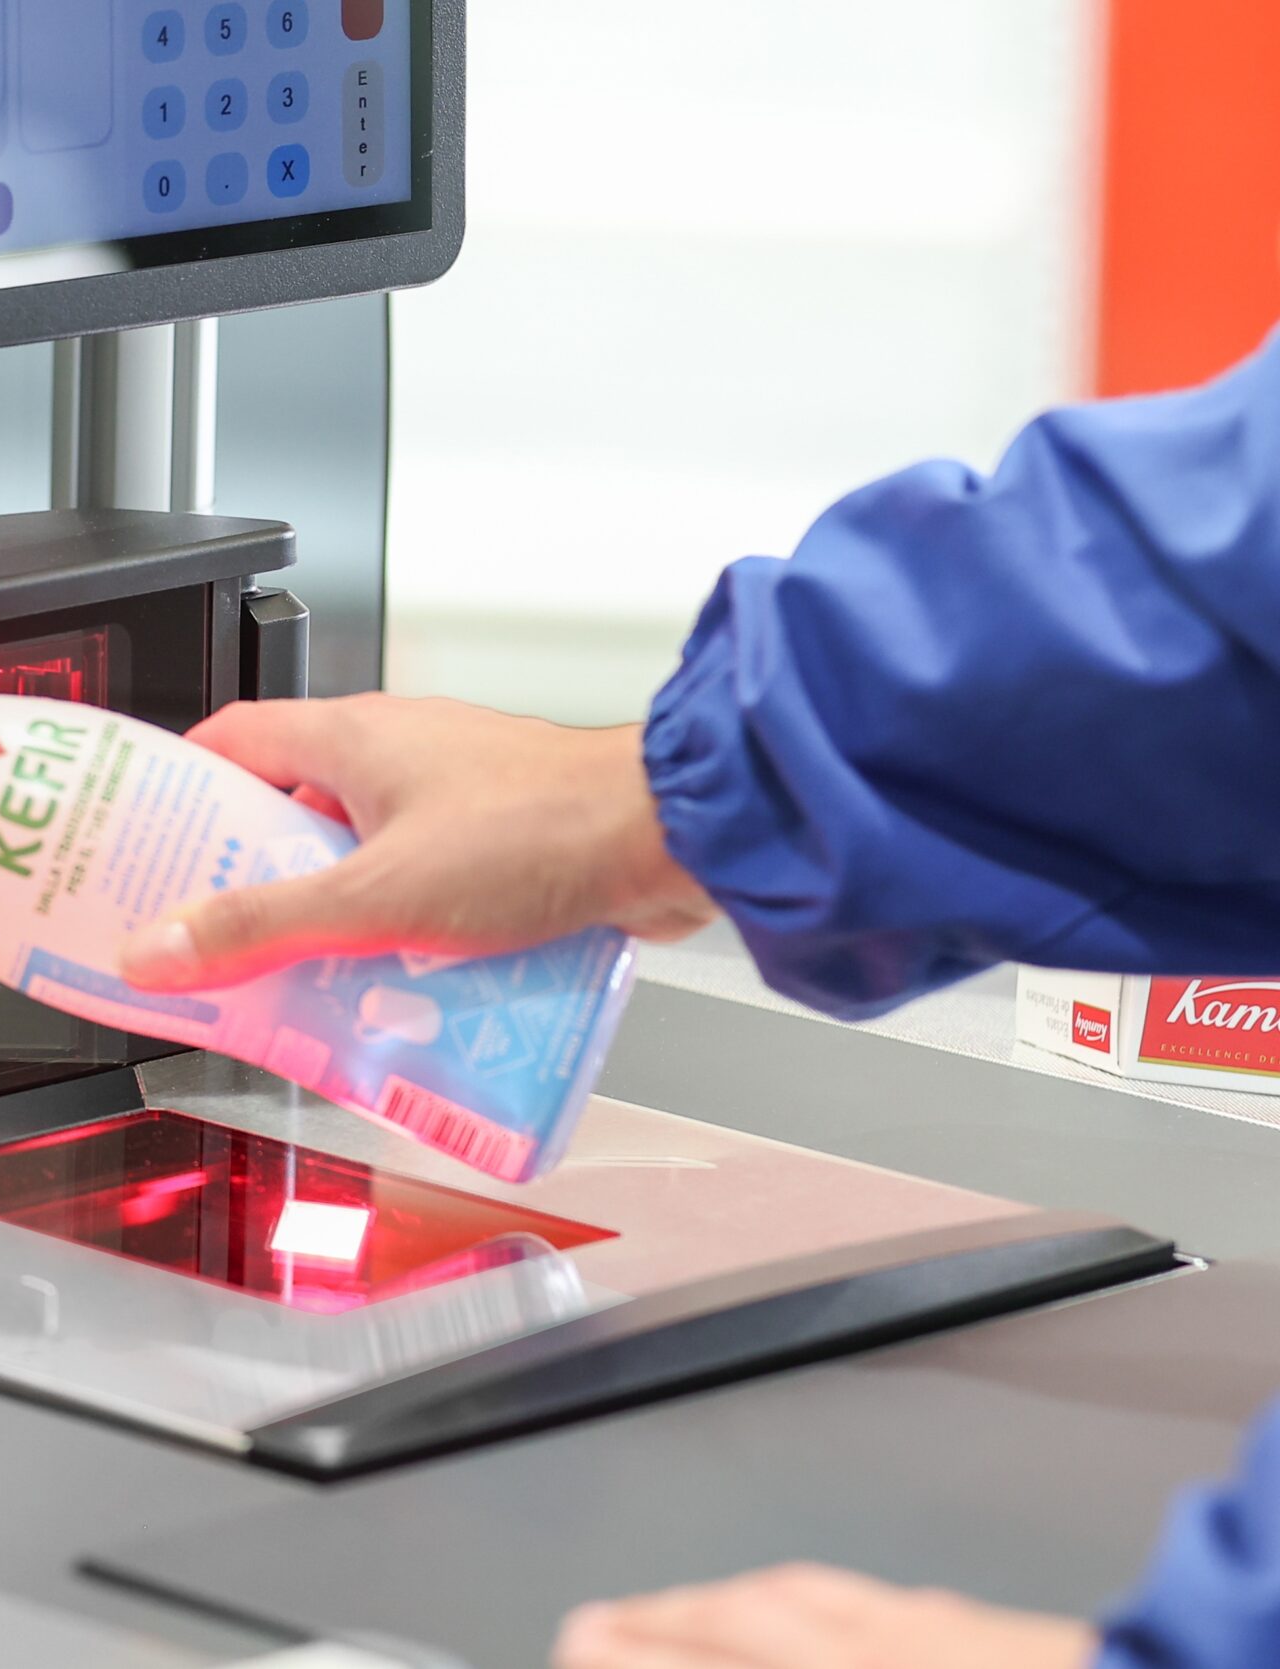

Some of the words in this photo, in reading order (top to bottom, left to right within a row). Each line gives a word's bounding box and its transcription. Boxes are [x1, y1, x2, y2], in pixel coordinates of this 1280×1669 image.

[220, 19, 231, 39] 5
[282, 12, 293, 32] 6
[157, 26, 168, 46] 4
[221, 95, 231, 115] 2
[283, 87, 293, 107] 3
[159, 103, 167, 122] 1
[357, 70, 368, 177] Enter
[281, 160, 294, 182] X
[159, 176, 170, 197] 0
[1166, 979, 1280, 1033] Kam
[1075, 1011, 1108, 1043] Kambly
[1161, 1043, 1250, 1061] EXCELLENCE
[1259, 1055, 1280, 1067] DE
